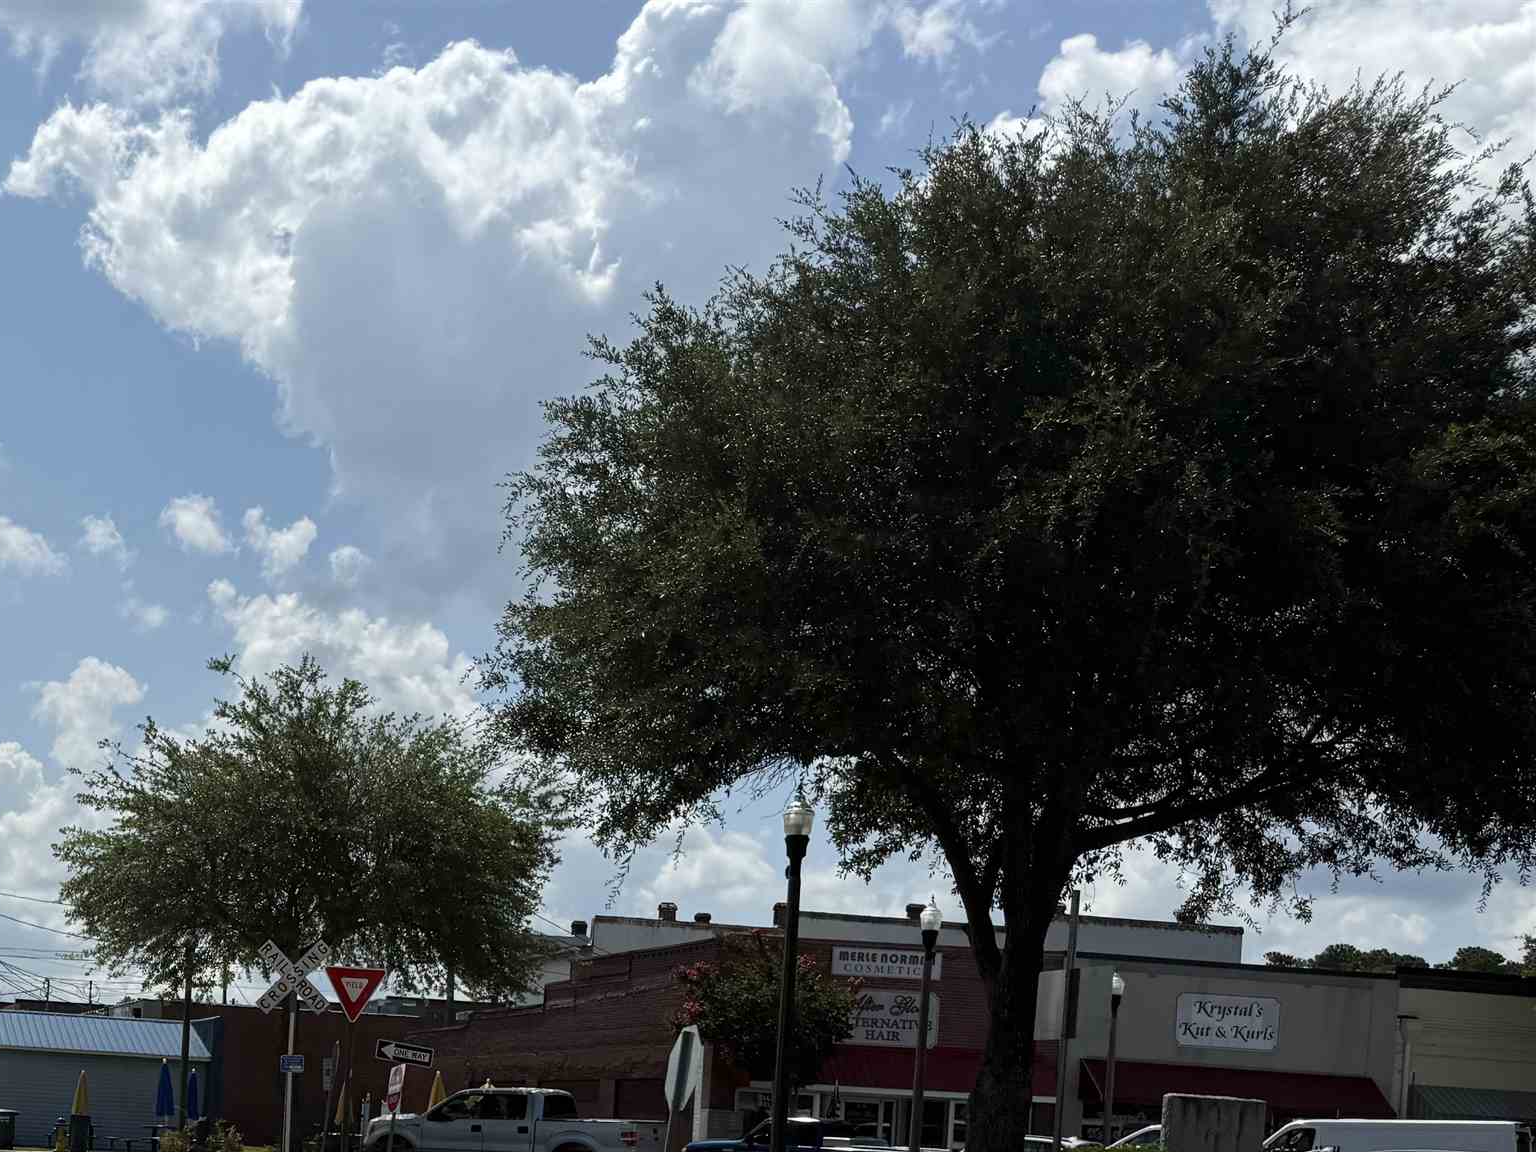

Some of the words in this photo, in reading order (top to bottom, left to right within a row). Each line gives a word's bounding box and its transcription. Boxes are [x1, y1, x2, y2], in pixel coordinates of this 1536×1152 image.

[839, 951, 878, 962] MERLE
[880, 953, 935, 966] NORM
[261, 943, 328, 1010] CROSSING
[843, 963, 924, 976] COSMETIC
[889, 995, 921, 1016] Glo
[1193, 1000, 1264, 1022] Krystal's
[864, 1030, 901, 1041] HAIR
[1179, 1022, 1211, 1039] Kut
[1215, 1026, 1226, 1039] &
[1230, 1025, 1275, 1042] Kurls
[394, 1048, 411, 1058] ONE
[412, 1051, 427, 1060] WAY
